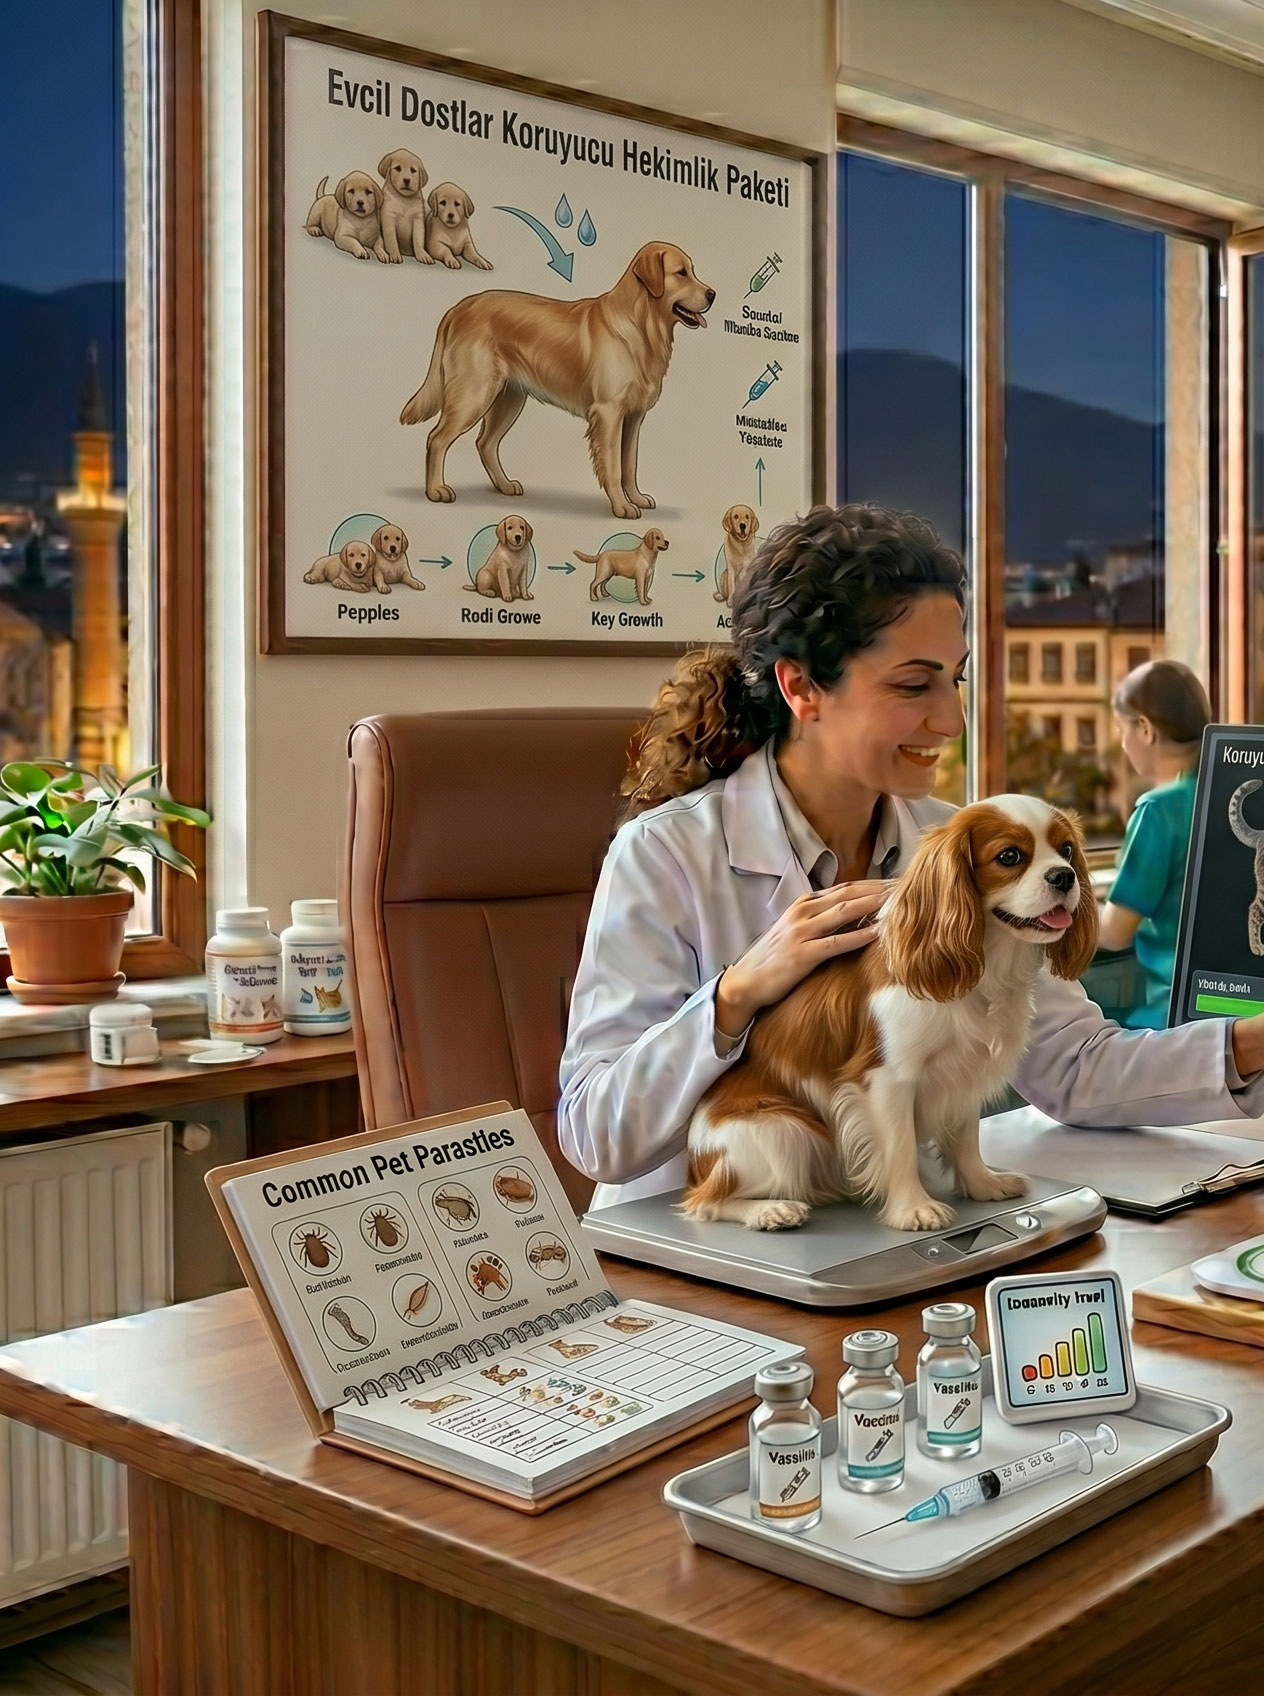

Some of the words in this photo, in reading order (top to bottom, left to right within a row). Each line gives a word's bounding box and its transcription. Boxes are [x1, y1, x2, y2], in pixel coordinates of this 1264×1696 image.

[328, 68, 390, 117] Evcil
[401, 86, 493, 139] Dostlar
[503, 110, 614, 167] Koruyucu
[623, 139, 719, 192] Hekimlik
[726, 163, 790, 207] Paketi
[337, 604, 400, 624] Pepples
[461, 607, 493, 625] Rodi
[497, 608, 541, 625] Growe
[591, 611, 616, 628] Key
[618, 611, 663, 628] Growth
[262, 1165, 371, 1208] Common
[371, 1151, 414, 1181] Pet
